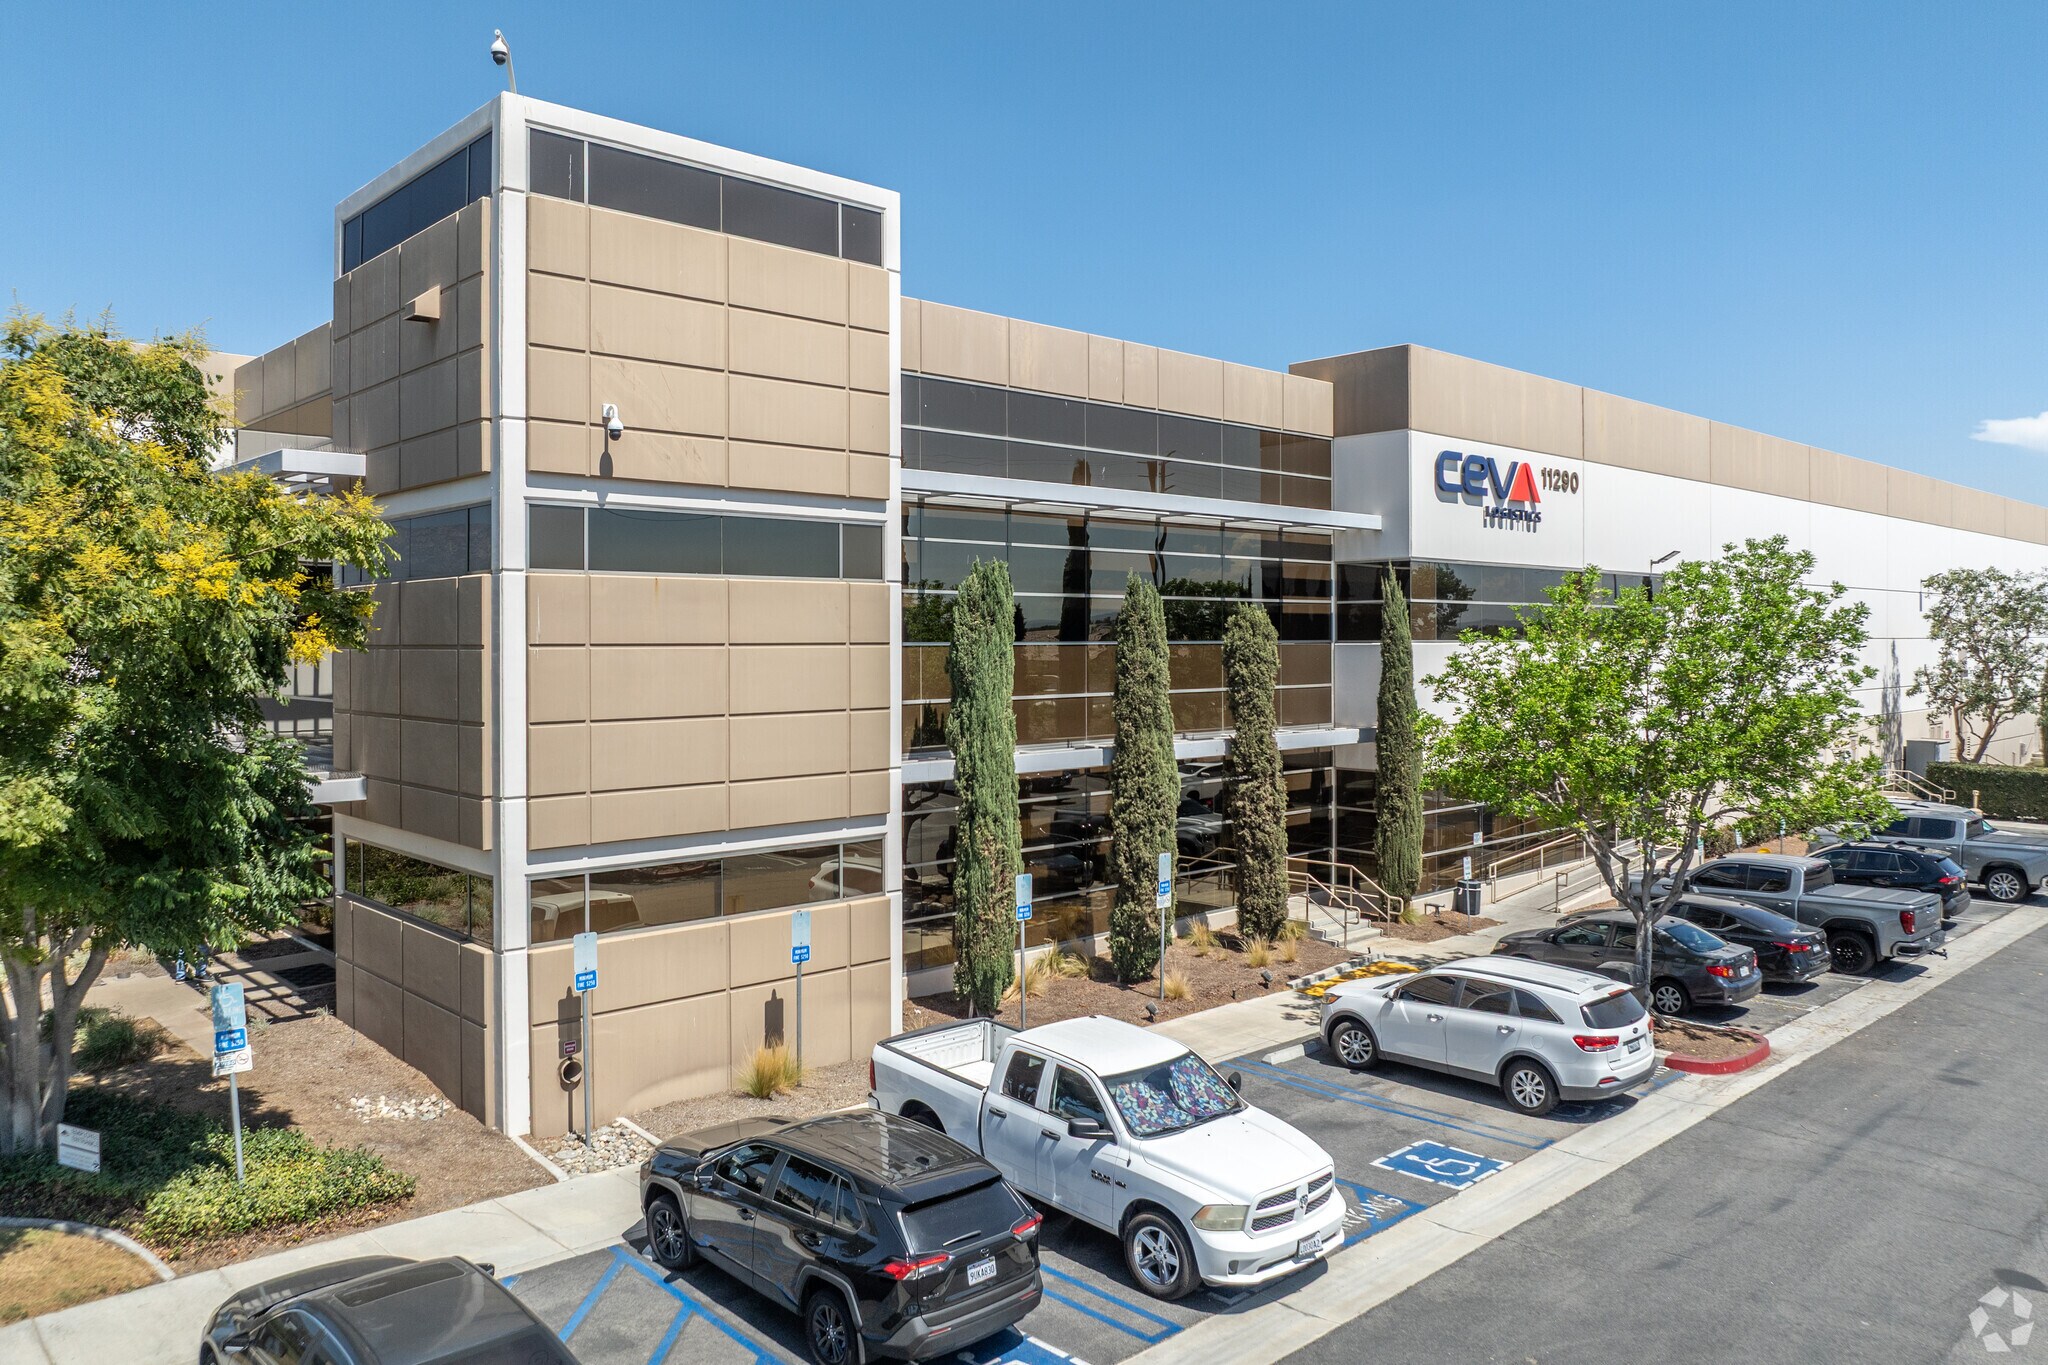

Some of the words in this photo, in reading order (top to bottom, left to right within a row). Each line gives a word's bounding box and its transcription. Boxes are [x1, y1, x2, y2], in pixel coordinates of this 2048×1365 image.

[1435, 450, 1541, 503] CEVA
[1541, 467, 1579, 495] 11290
[1484, 505, 1542, 523] LOGISTICS
[586, 979, 596, 987] $250
